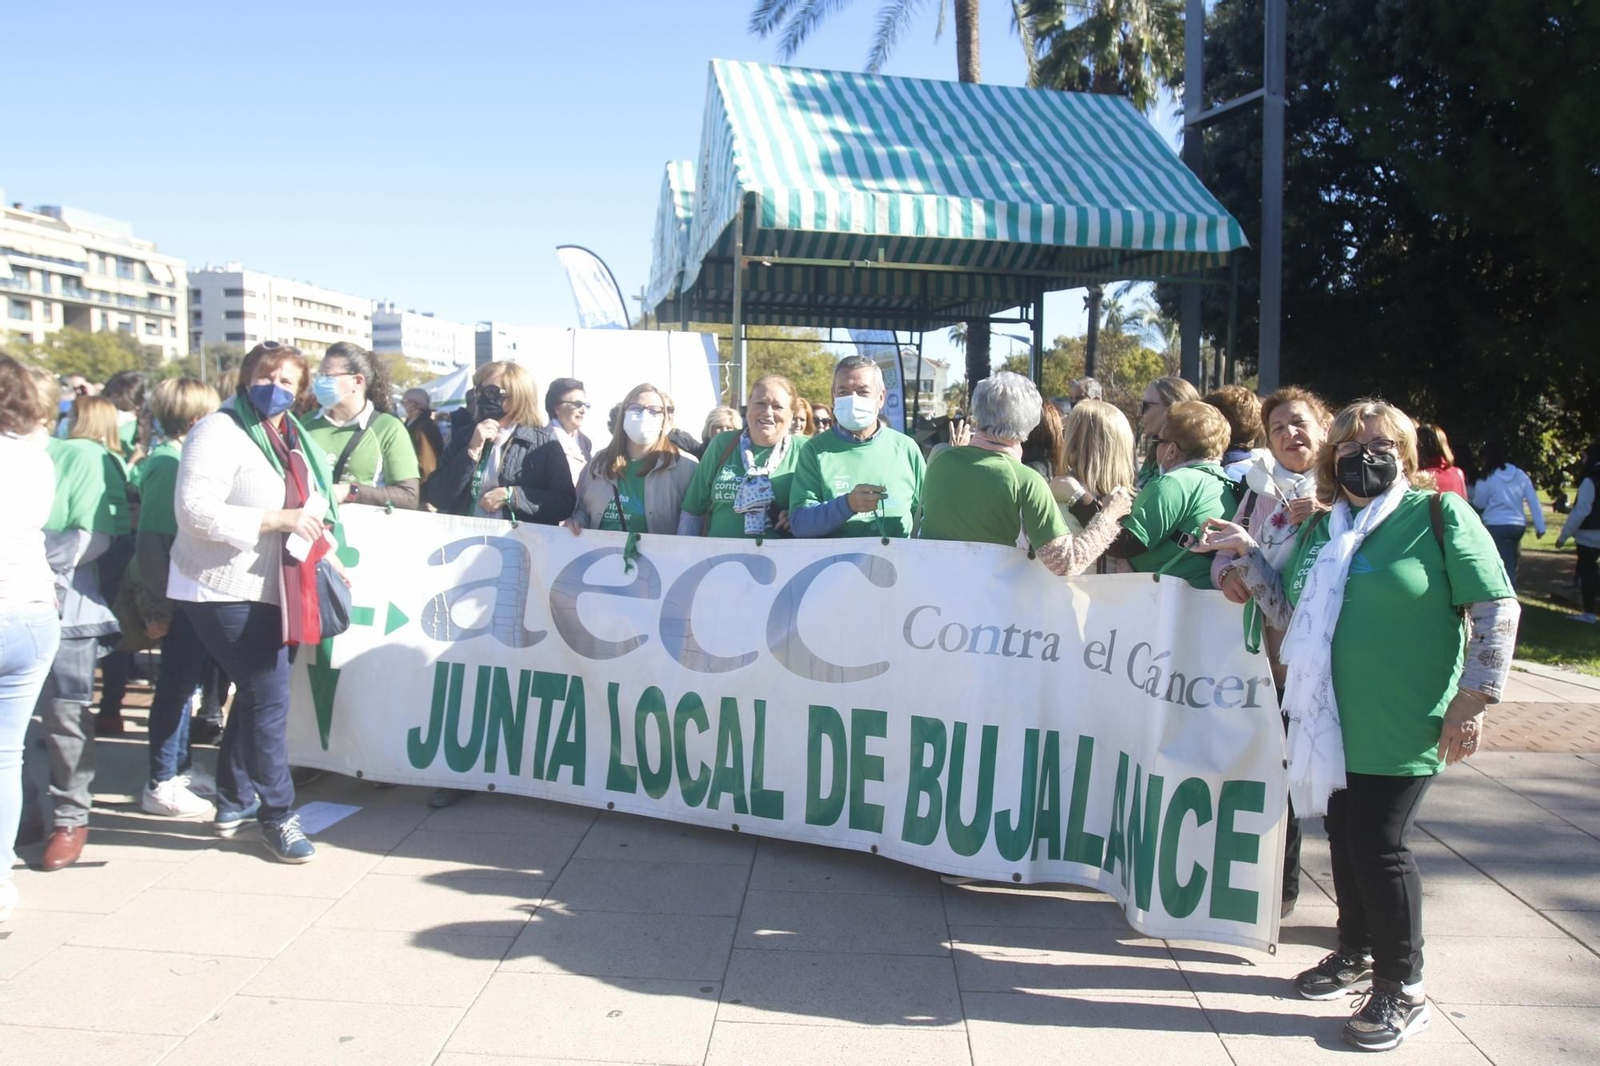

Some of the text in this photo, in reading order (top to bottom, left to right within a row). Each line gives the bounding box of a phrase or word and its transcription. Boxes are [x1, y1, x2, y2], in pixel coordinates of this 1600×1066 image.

[714, 482, 741, 491] contr
[714, 490, 723, 500] el
[604, 511, 632, 520] cáner
[1293, 577, 1304, 589] el
[421, 534, 897, 684] aecc
[902, 605, 1062, 663] Contra
[1083, 629, 1117, 675] el
[1126, 641, 1271, 709] Cáncer
[406, 661, 1266, 925] JUNTA LOCAL DE BUJALANCE
